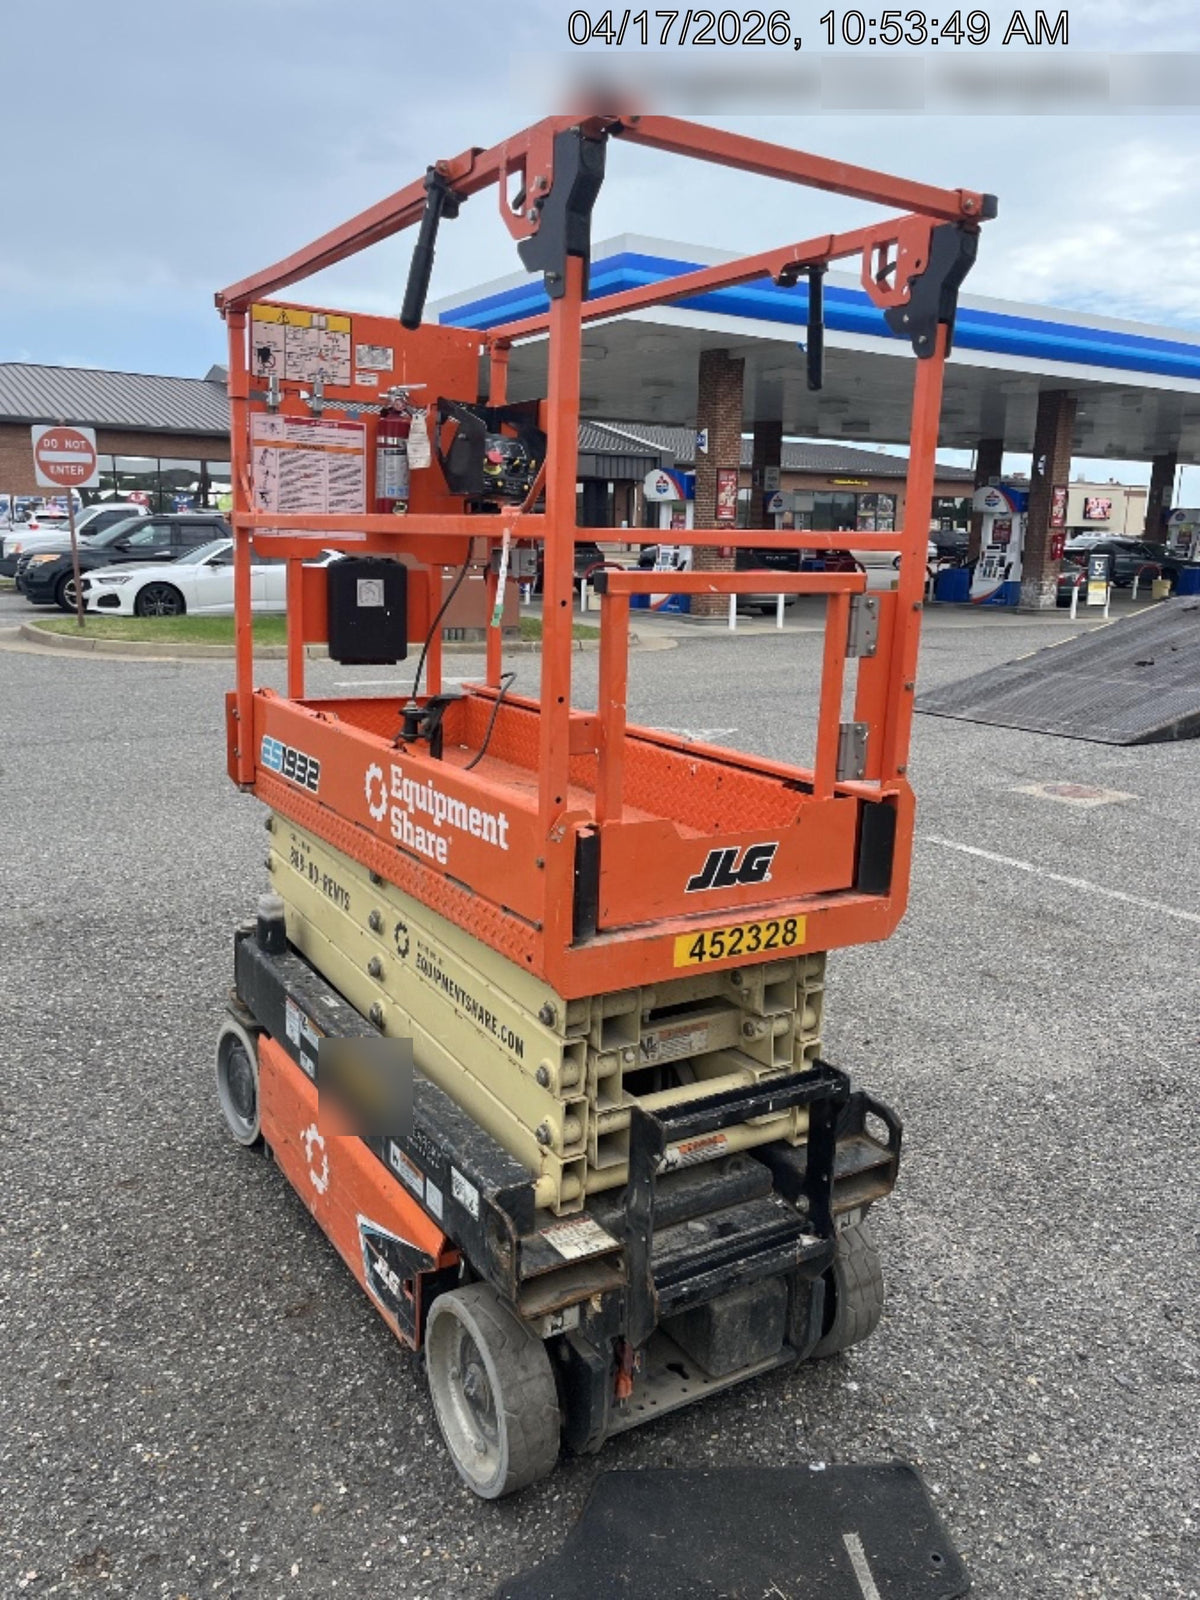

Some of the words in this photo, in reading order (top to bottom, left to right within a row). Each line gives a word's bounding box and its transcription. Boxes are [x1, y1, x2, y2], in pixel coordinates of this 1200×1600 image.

[43, 438, 58, 449] DO
[64, 439, 86, 449] NOT
[49, 465, 84, 476] ENTER
[261, 734, 320, 794] ES1932
[390, 763, 509, 851] Equipment
[390, 805, 448, 865] Share
[685, 841, 779, 893] JLG
[689, 918, 797, 963] 452328
